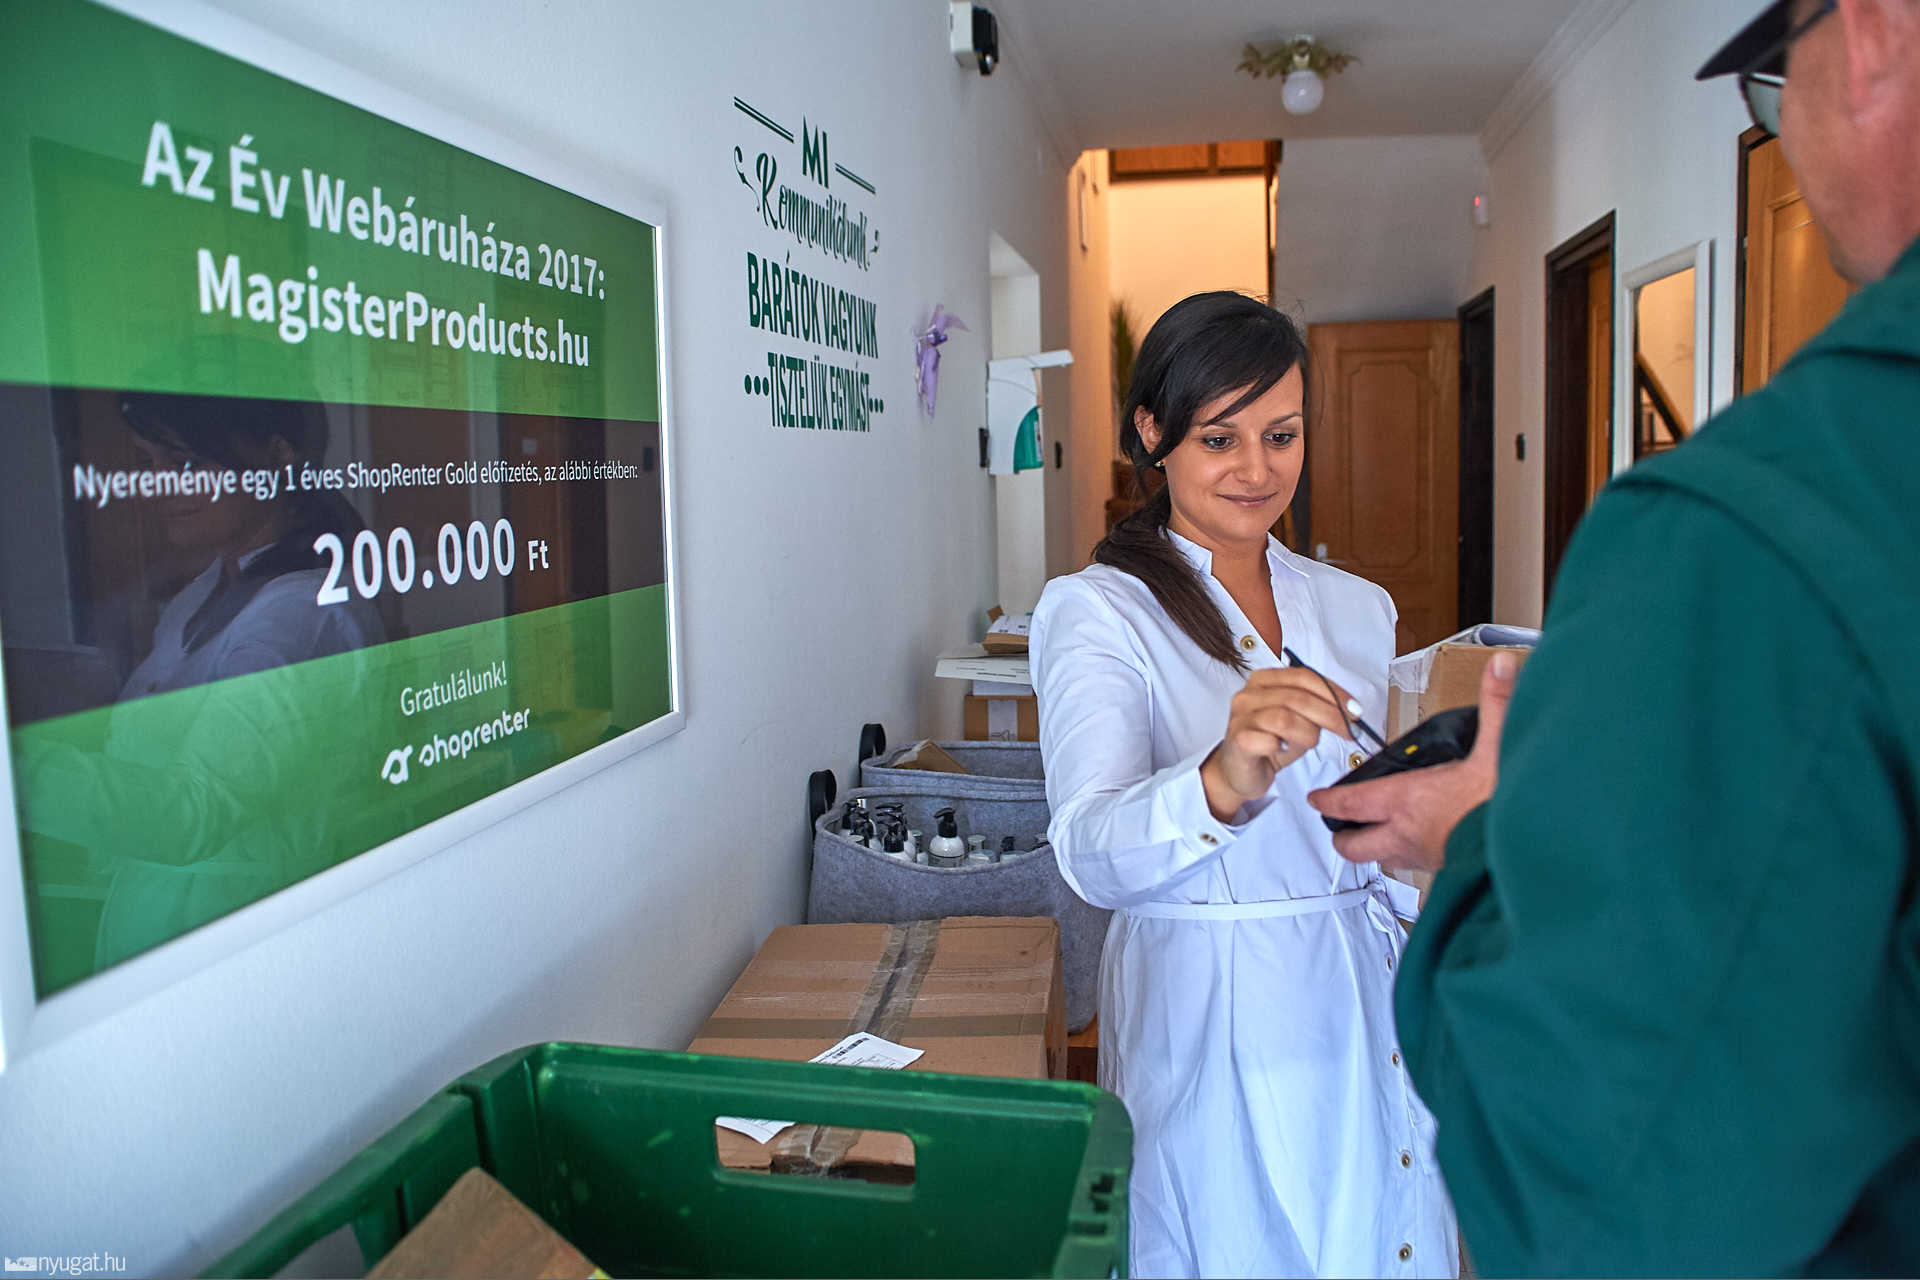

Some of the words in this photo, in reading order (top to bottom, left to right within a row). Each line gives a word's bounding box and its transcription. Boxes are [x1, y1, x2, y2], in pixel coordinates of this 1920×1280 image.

[802, 113, 829, 189] MI
[141, 120, 215, 202] Az
[229, 134, 290, 220] Év
[303, 167, 531, 282] Webáruháza
[537, 243, 606, 300] 2017:
[196, 248, 590, 368] MagisterProducts.hu
[747, 249, 821, 345] BARÁTOK
[821, 282, 878, 359] VAGYUNK
[767, 352, 831, 430] TISZTELJÜK
[829, 360, 870, 432] EGYMÁST
[73, 462, 237, 509] Nyereménye
[241, 469, 280, 500] egy
[285, 464, 297, 492] 1
[301, 461, 343, 490] éves
[347, 461, 442, 494] ShopRenter
[445, 460, 478, 485] Gold
[480, 459, 542, 486] előfizetés,
[544, 465, 557, 481] az
[559, 459, 592, 481] alábbi
[593, 459, 639, 480] értékben:
[313, 517, 516, 606] 200.000
[527, 539, 549, 571] Ft
[400, 660, 508, 716] Gratulálunk!
[418, 707, 531, 767] shoprenter
